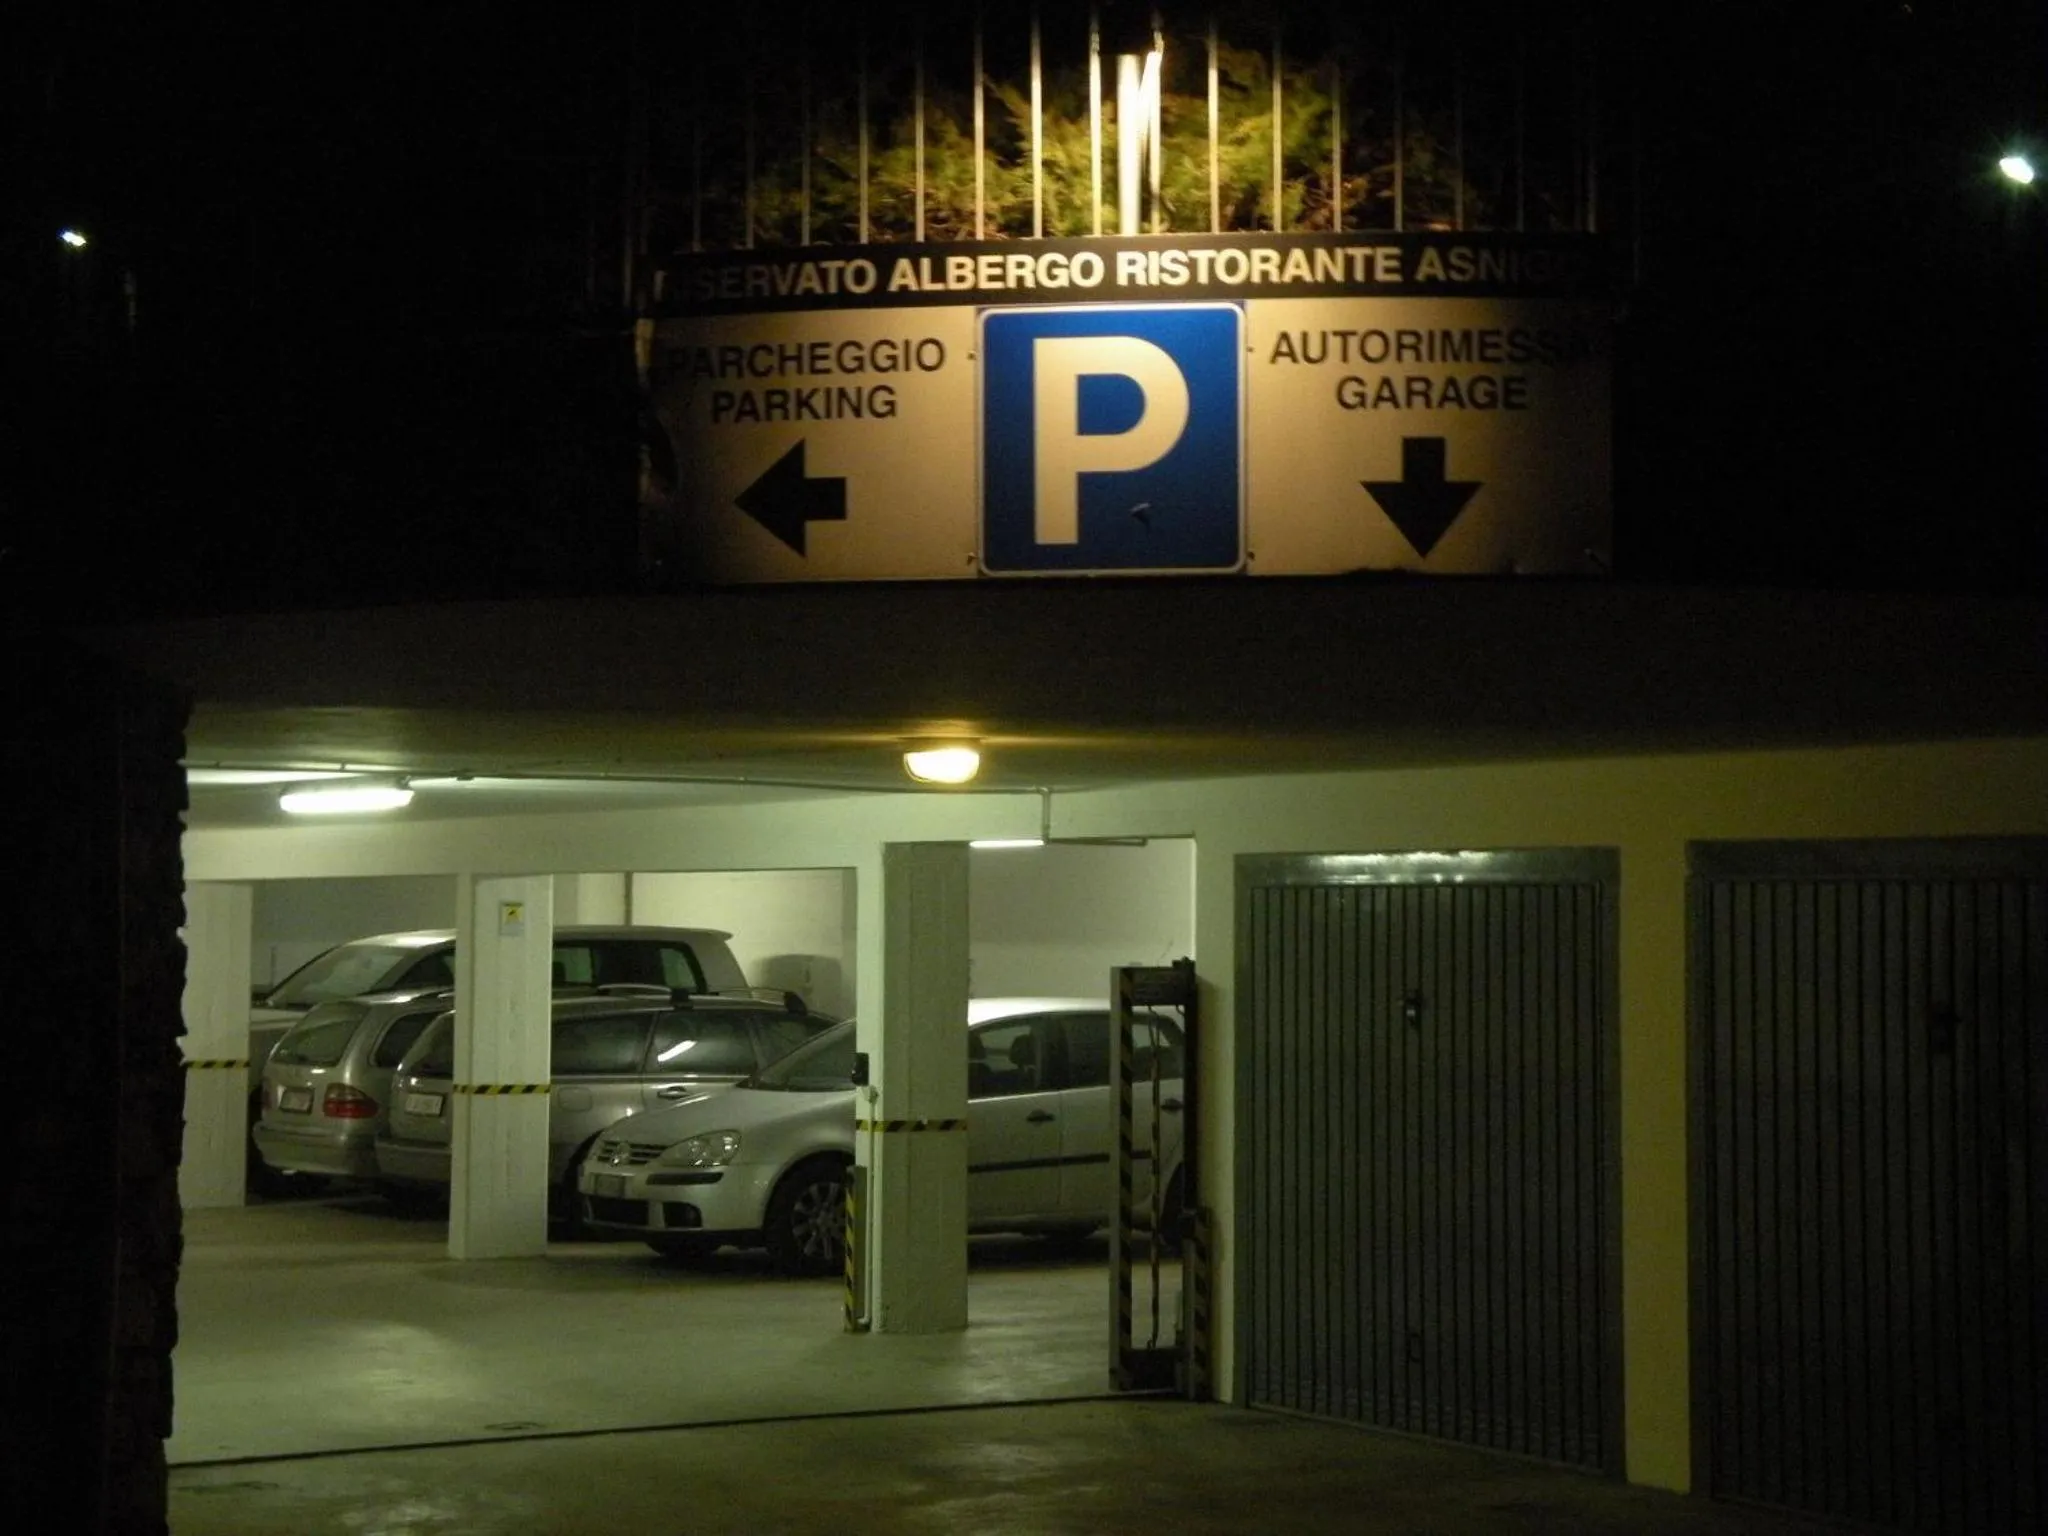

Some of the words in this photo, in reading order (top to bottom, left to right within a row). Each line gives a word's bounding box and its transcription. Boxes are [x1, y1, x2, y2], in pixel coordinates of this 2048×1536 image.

[887, 252, 1106, 293] ALBERGO
[1116, 243, 1403, 286] RISTORANTE
[712, 385, 897, 423] PARKING
[1337, 376, 1530, 411] GARAGE
[1032, 336, 1190, 545] P
